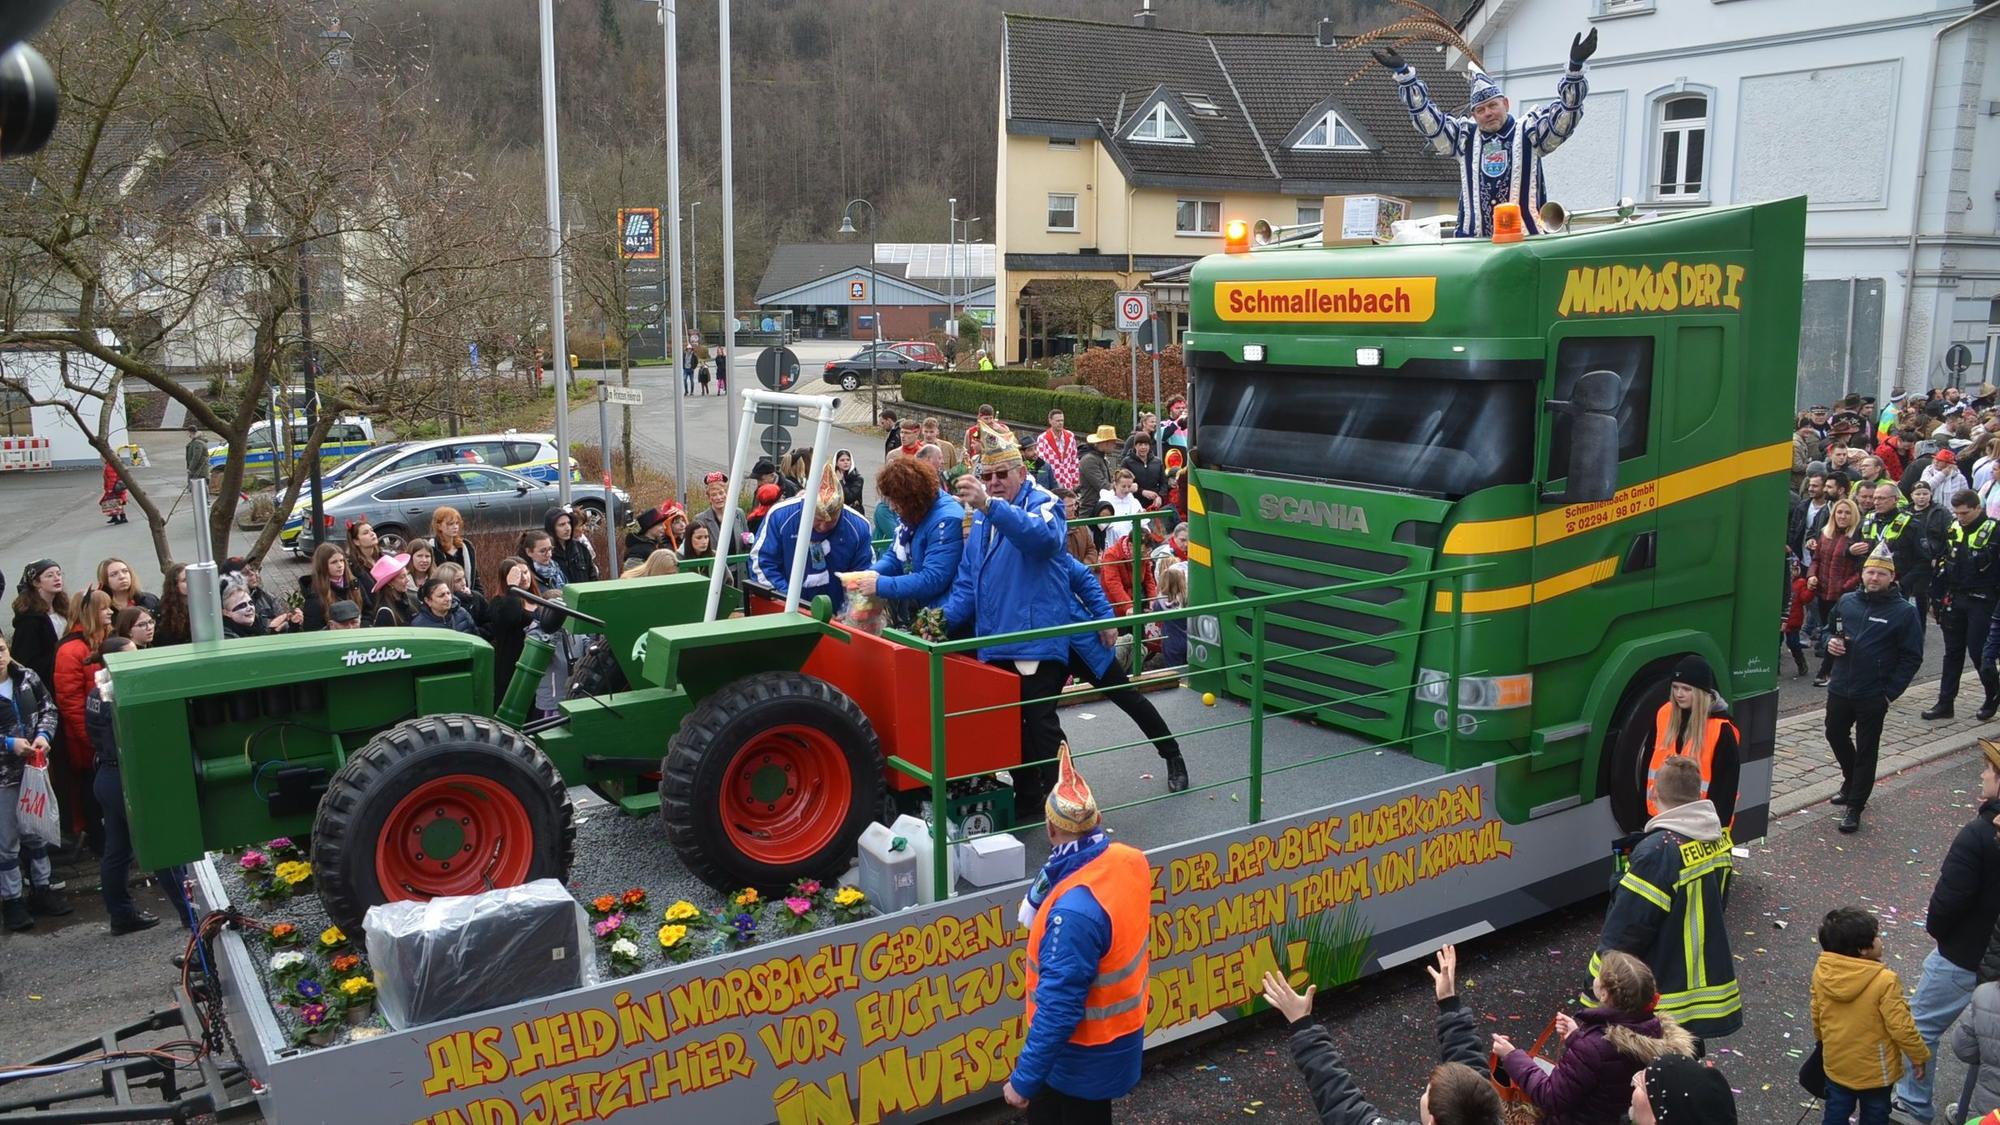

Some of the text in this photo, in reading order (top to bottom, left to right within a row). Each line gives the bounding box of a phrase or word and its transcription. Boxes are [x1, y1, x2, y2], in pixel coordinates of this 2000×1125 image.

[1229, 287, 1410, 313] Schmallenbach
[1557, 261, 1745, 317] MARKUS DER I
[1127, 303, 1139, 314] 30
[1631, 483, 1655, 498] GmbH
[1259, 494, 1370, 534] SCANIA
[1578, 512, 1608, 529] 02294
[1616, 506, 1628, 518] 98
[1630, 501, 1641, 514] 07
[341, 647, 412, 667] Holder
[422, 1026, 510, 1096] ALS
[510, 1008, 619, 1076] HELD
[670, 943, 859, 1034] MORSBACH
[860, 905, 1013, 983] GEBOREN,
[1169, 852, 1222, 896] DER
[1345, 784, 1482, 854] AUSERKOREN
[520, 1058, 651, 1125] JETZT
[758, 1007, 846, 1069] VOR
[855, 973, 962, 1048] EUCH
[953, 961, 1005, 1015] ZU
[1289, 857, 1373, 919] TRAUM
[1372, 846, 1416, 895] VON
[1418, 820, 1513, 879] KARNEVAL
